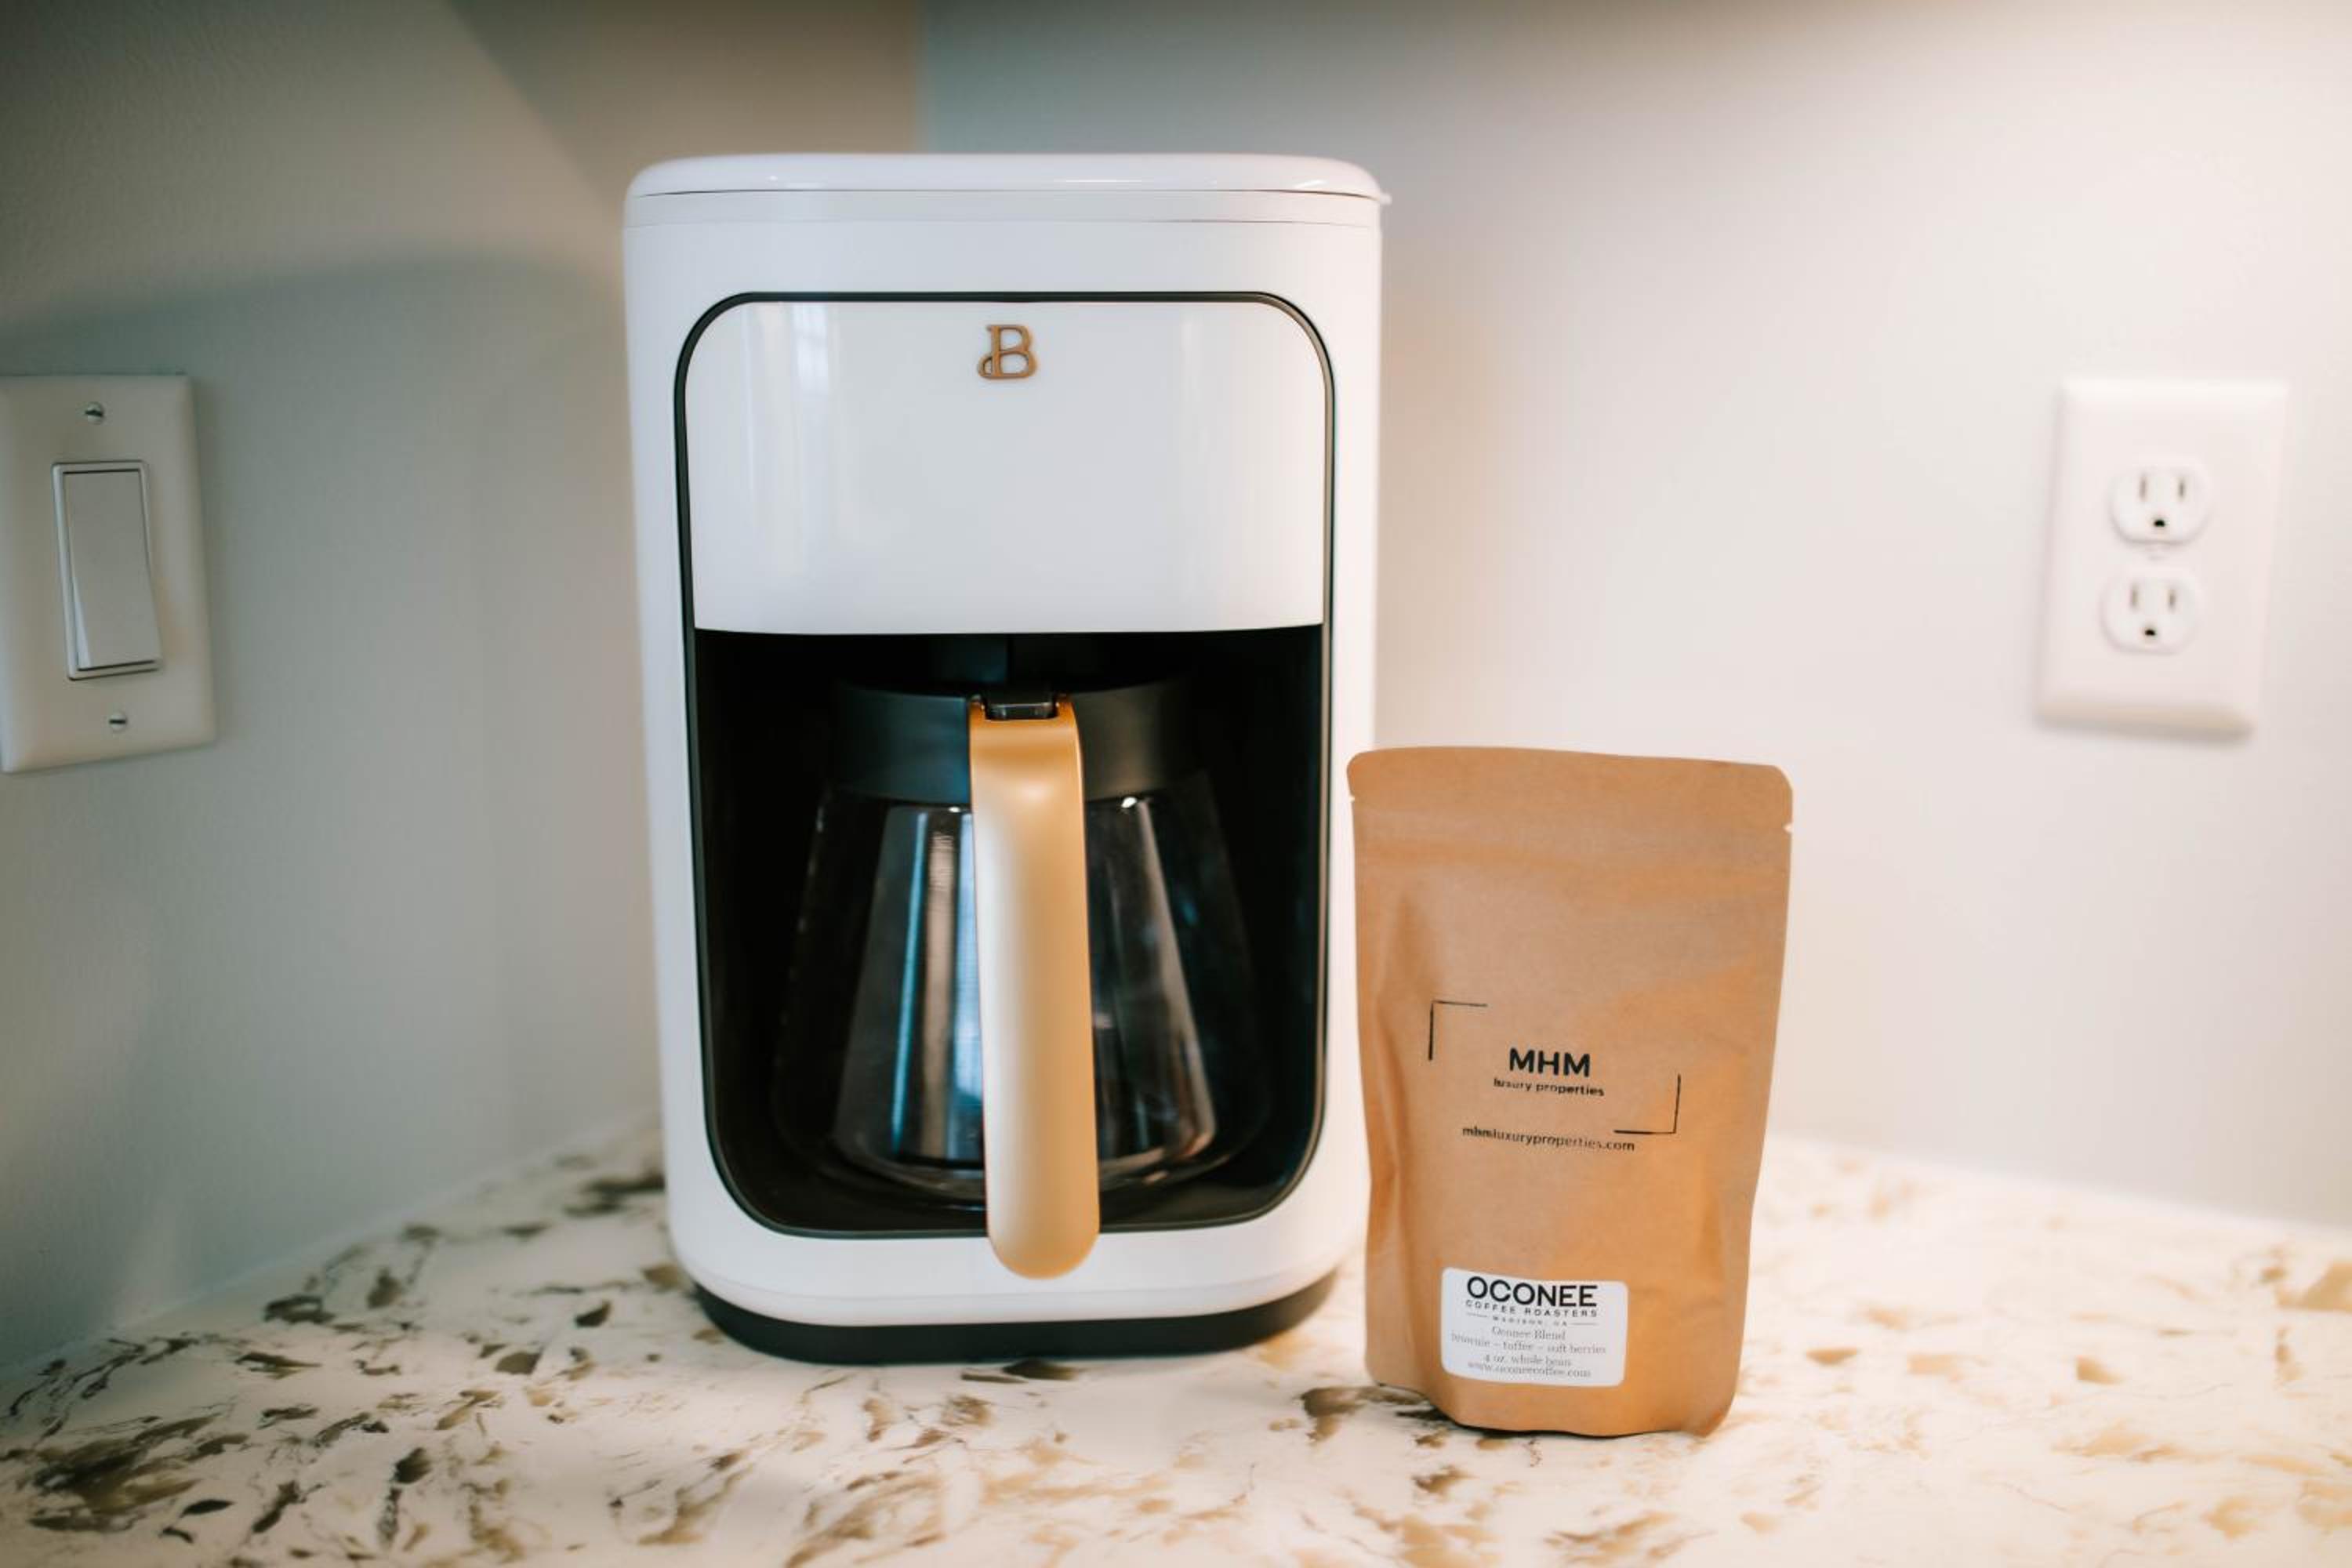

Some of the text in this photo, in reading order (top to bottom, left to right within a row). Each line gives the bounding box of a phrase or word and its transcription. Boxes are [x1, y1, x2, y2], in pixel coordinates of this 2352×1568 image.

[1509, 1047, 1591, 1077] MHM
[1494, 1077, 1605, 1097] luxury properties
[1462, 1126, 1635, 1152] mhmluxuryproperties.com
[1467, 1276, 1598, 1307] OCONEE
[1466, 1300, 1598, 1318] COFFEE ROASTERS
[1534, 1330, 1566, 1341] Blend
[1503, 1340, 1531, 1351] toffee
[1570, 1344, 1606, 1355] berries
